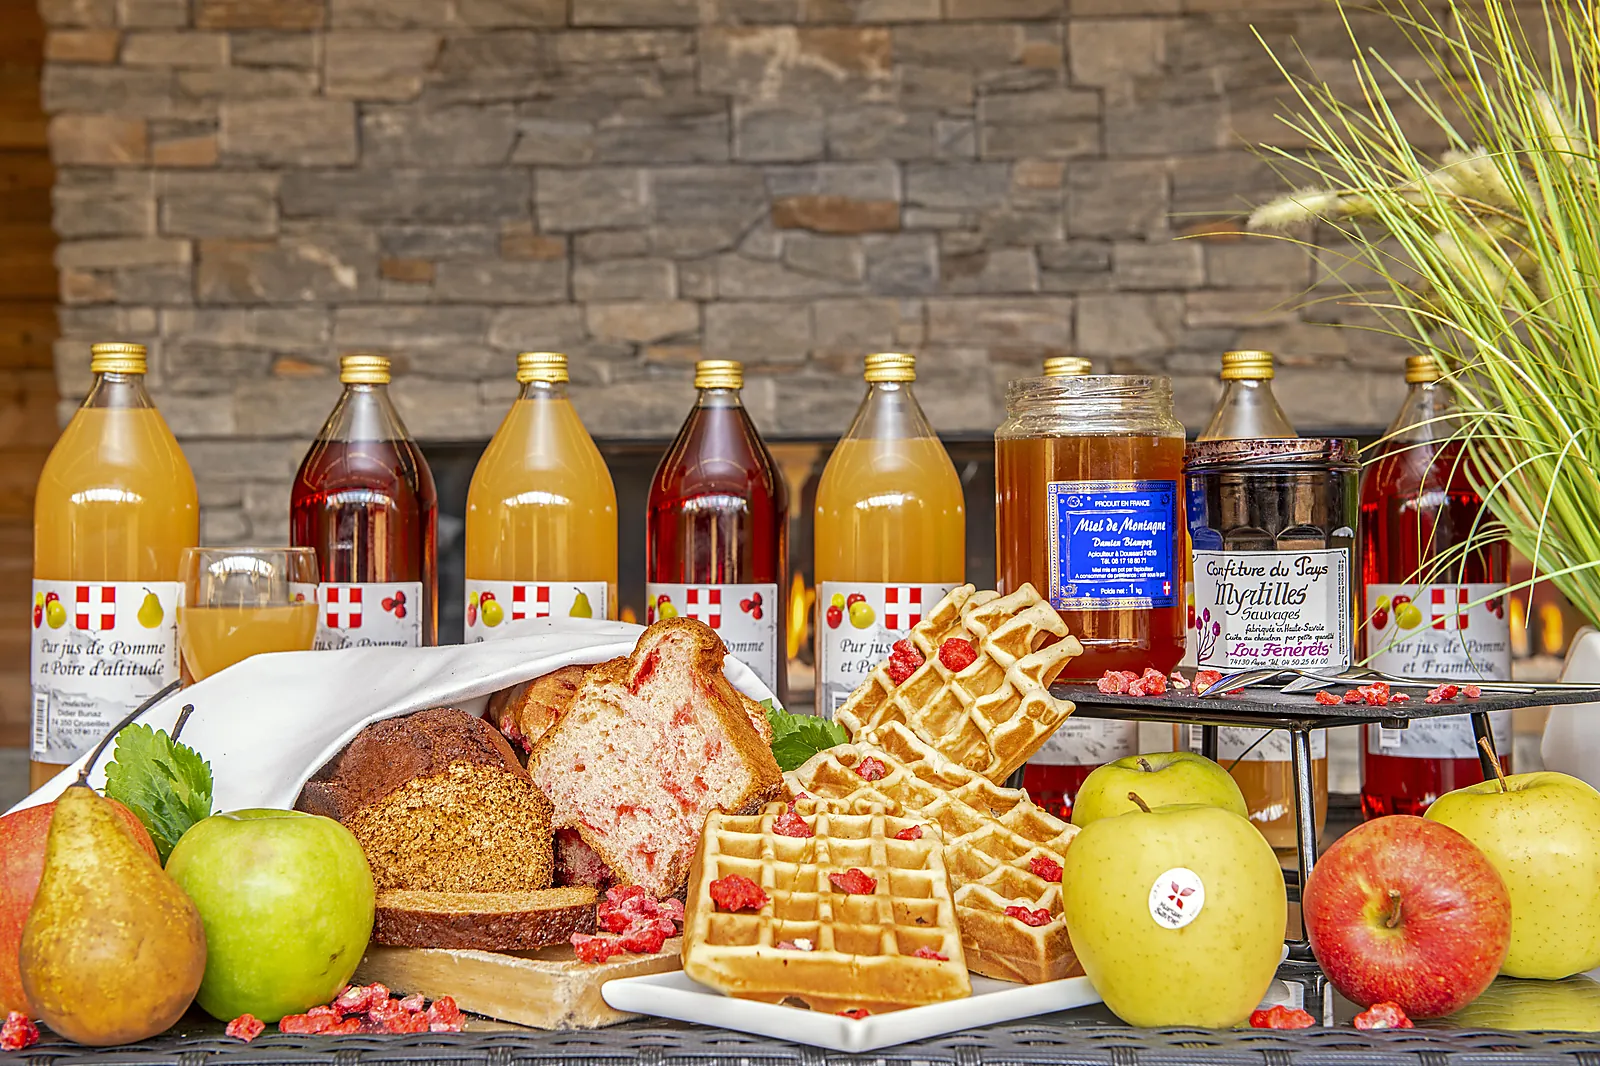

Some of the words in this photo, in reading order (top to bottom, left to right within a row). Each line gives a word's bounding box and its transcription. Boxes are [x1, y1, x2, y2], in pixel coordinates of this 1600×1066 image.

[1073, 517, 1103, 535] Miel
[1106, 518, 1118, 532] de
[1118, 517, 1166, 535] Montagne
[1092, 537, 1121, 547] Damien
[1206, 559, 1266, 581] Confiture
[1269, 561, 1290, 577] du
[1294, 556, 1329, 582] Pays
[1129, 583, 1134, 594] 1
[1135, 587, 1142, 595] kg
[1214, 580, 1309, 616] Myrtilles
[1241, 607, 1301, 626] Sauvages
[1245, 623, 1275, 635] fabriquée
[840, 638, 866, 653] Pur
[866, 638, 892, 658] jus
[1285, 635, 1296, 644] par
[1413, 639, 1439, 659] jus
[1443, 637, 1460, 653] de
[40, 638, 59, 654] Pur
[59, 639, 82, 660] jus
[86, 639, 104, 655] de
[109, 640, 166, 656] Pomme
[40, 662, 49, 674] et
[51, 660, 85, 676] Poire
[89, 658, 165, 676] d'altitude
[840, 661, 852, 673] et
[1403, 662, 1416, 673] et
[1422, 659, 1494, 673] Framboise
